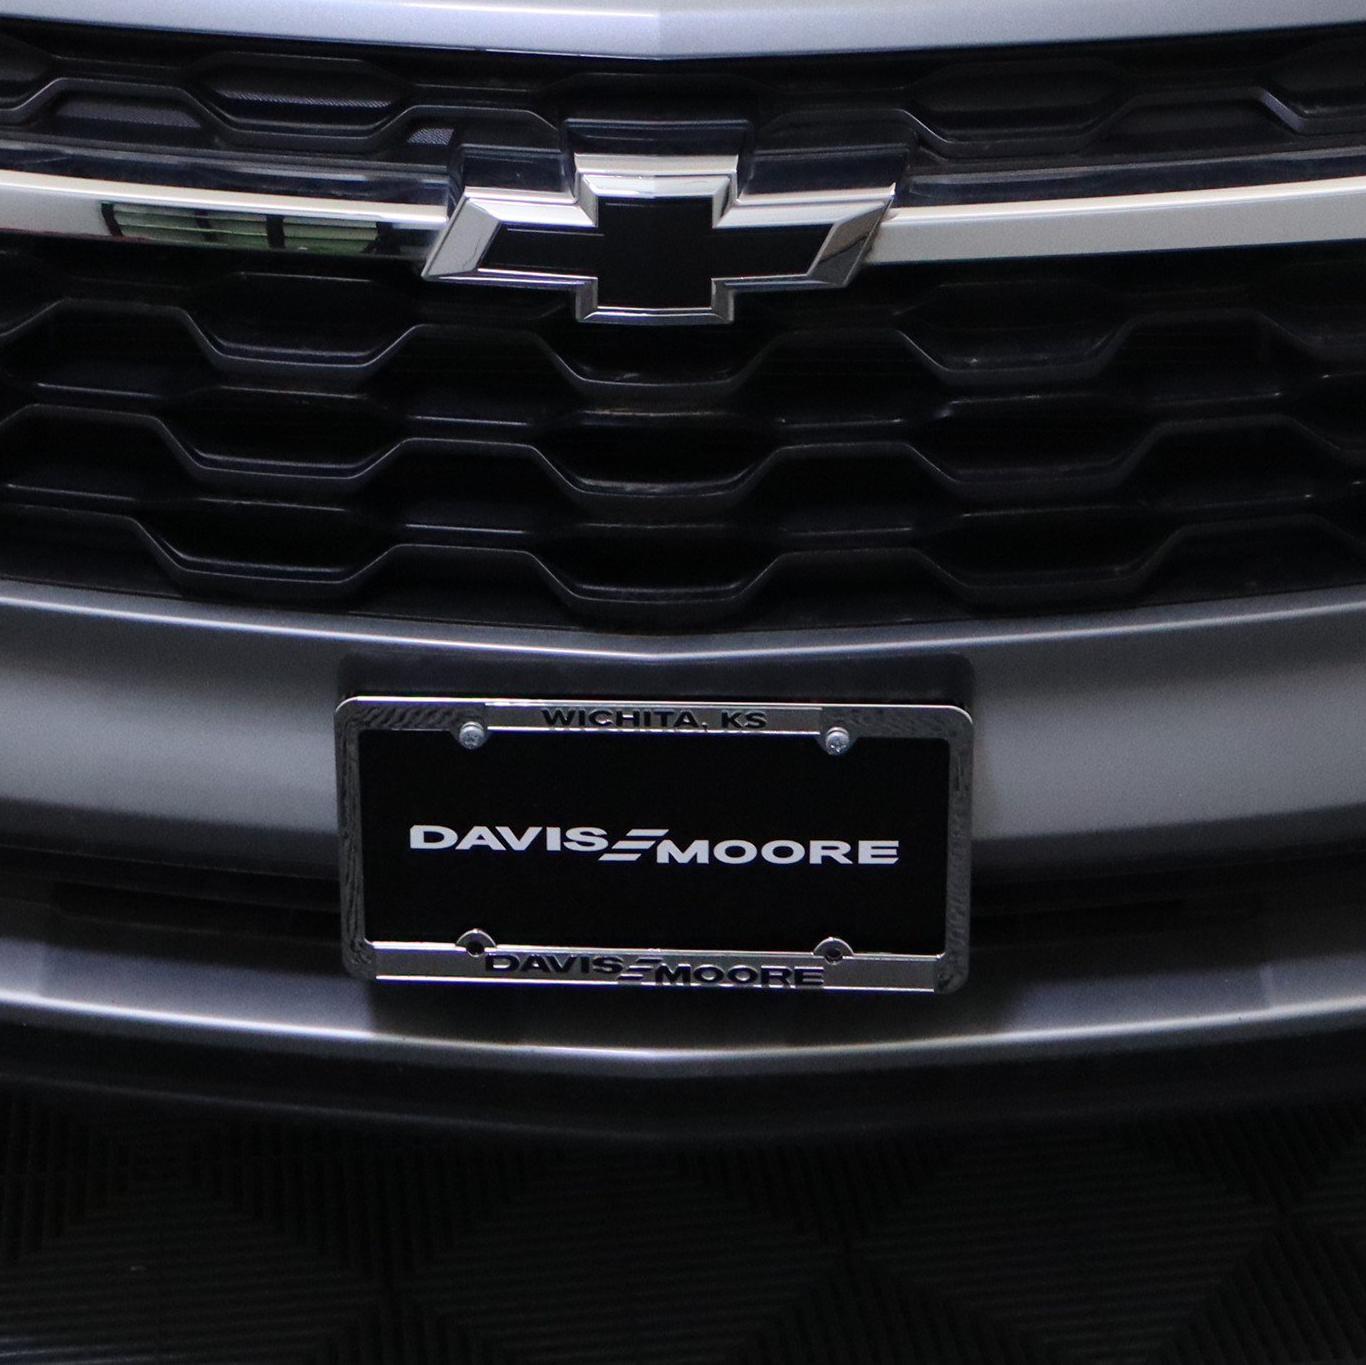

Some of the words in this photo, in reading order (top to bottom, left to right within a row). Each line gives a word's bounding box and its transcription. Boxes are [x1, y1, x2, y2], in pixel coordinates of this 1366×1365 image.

[721, 710, 768, 730] KS
[409, 824, 612, 851] DAVIS
[656, 838, 900, 865] MOORE
[485, 954, 628, 976] DAVIS
[655, 963, 825, 988] MOORE
